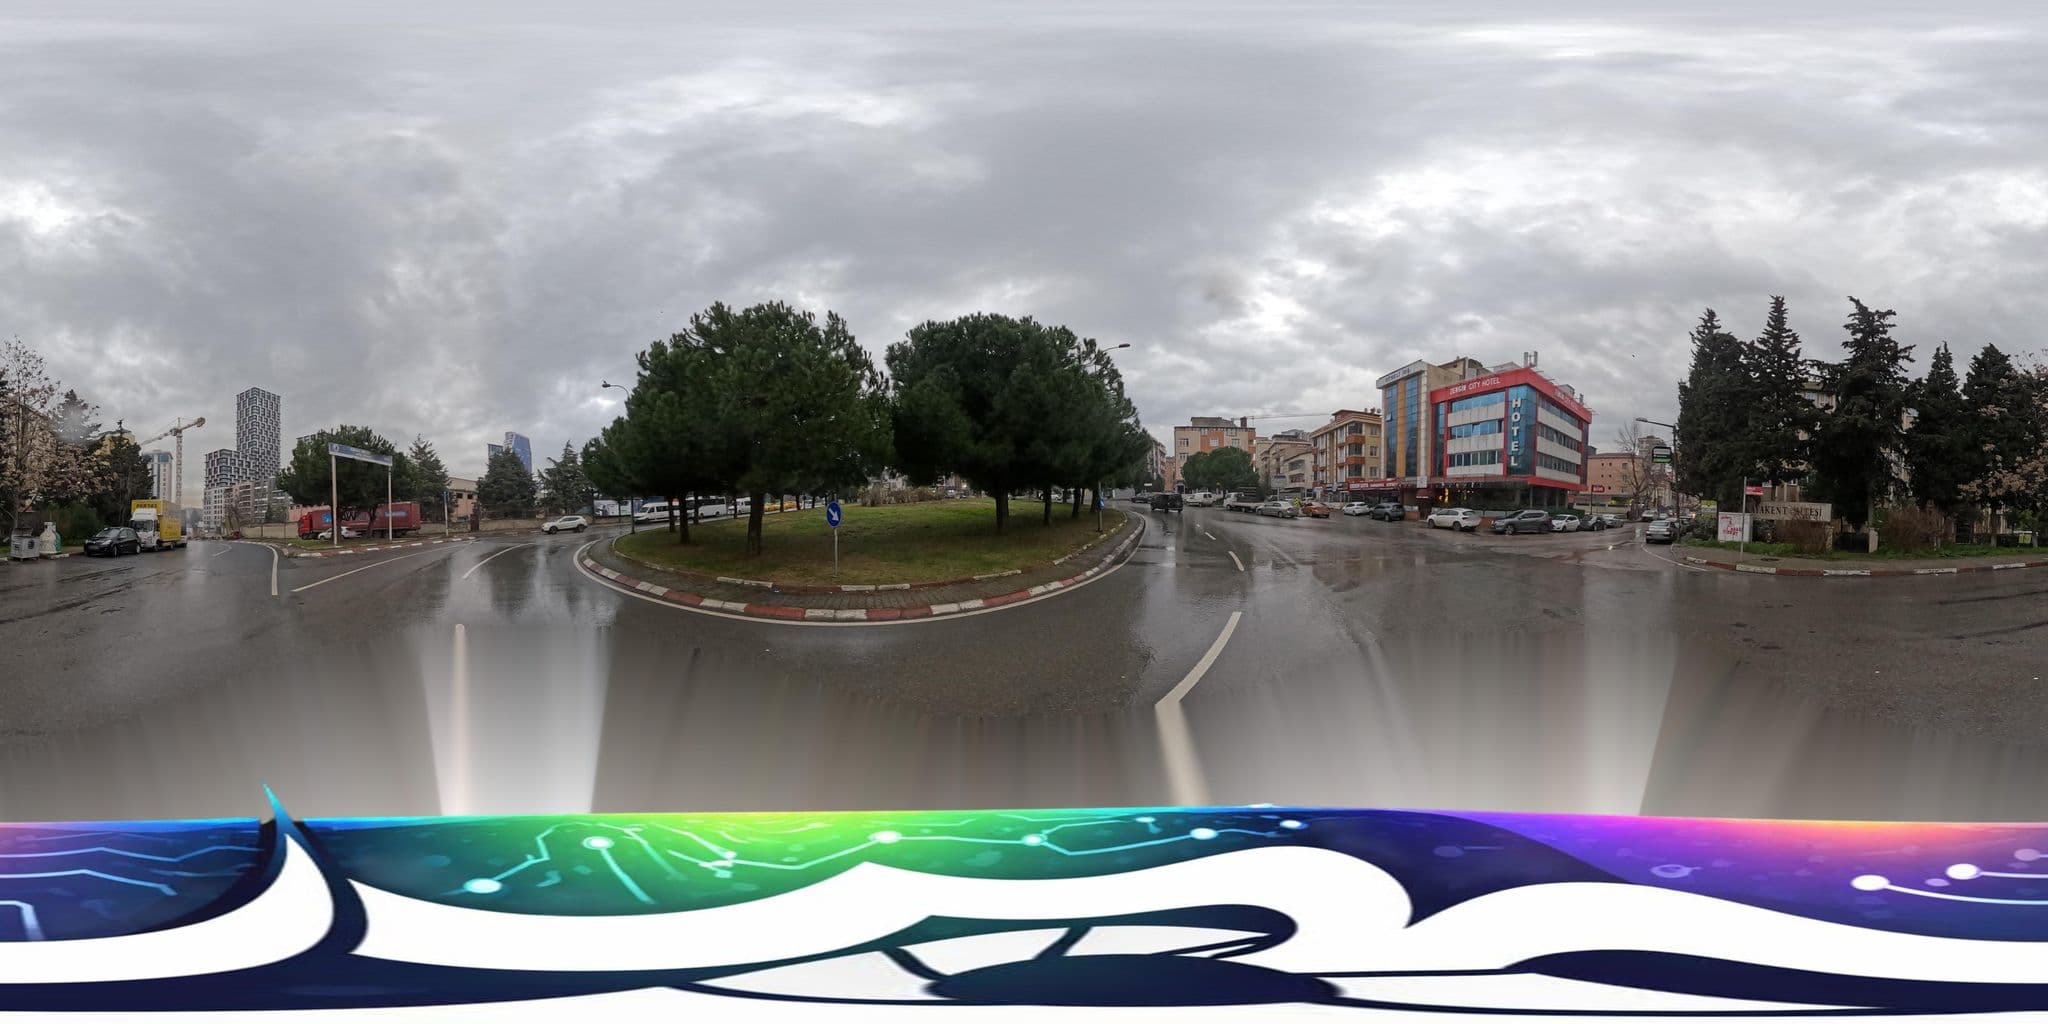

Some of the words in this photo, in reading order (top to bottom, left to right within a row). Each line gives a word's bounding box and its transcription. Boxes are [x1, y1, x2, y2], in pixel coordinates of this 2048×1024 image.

[1468, 381, 1481, 390] CITY
[1482, 377, 1501, 387] HOTEL
[1511, 398, 1521, 466] HOTEL
